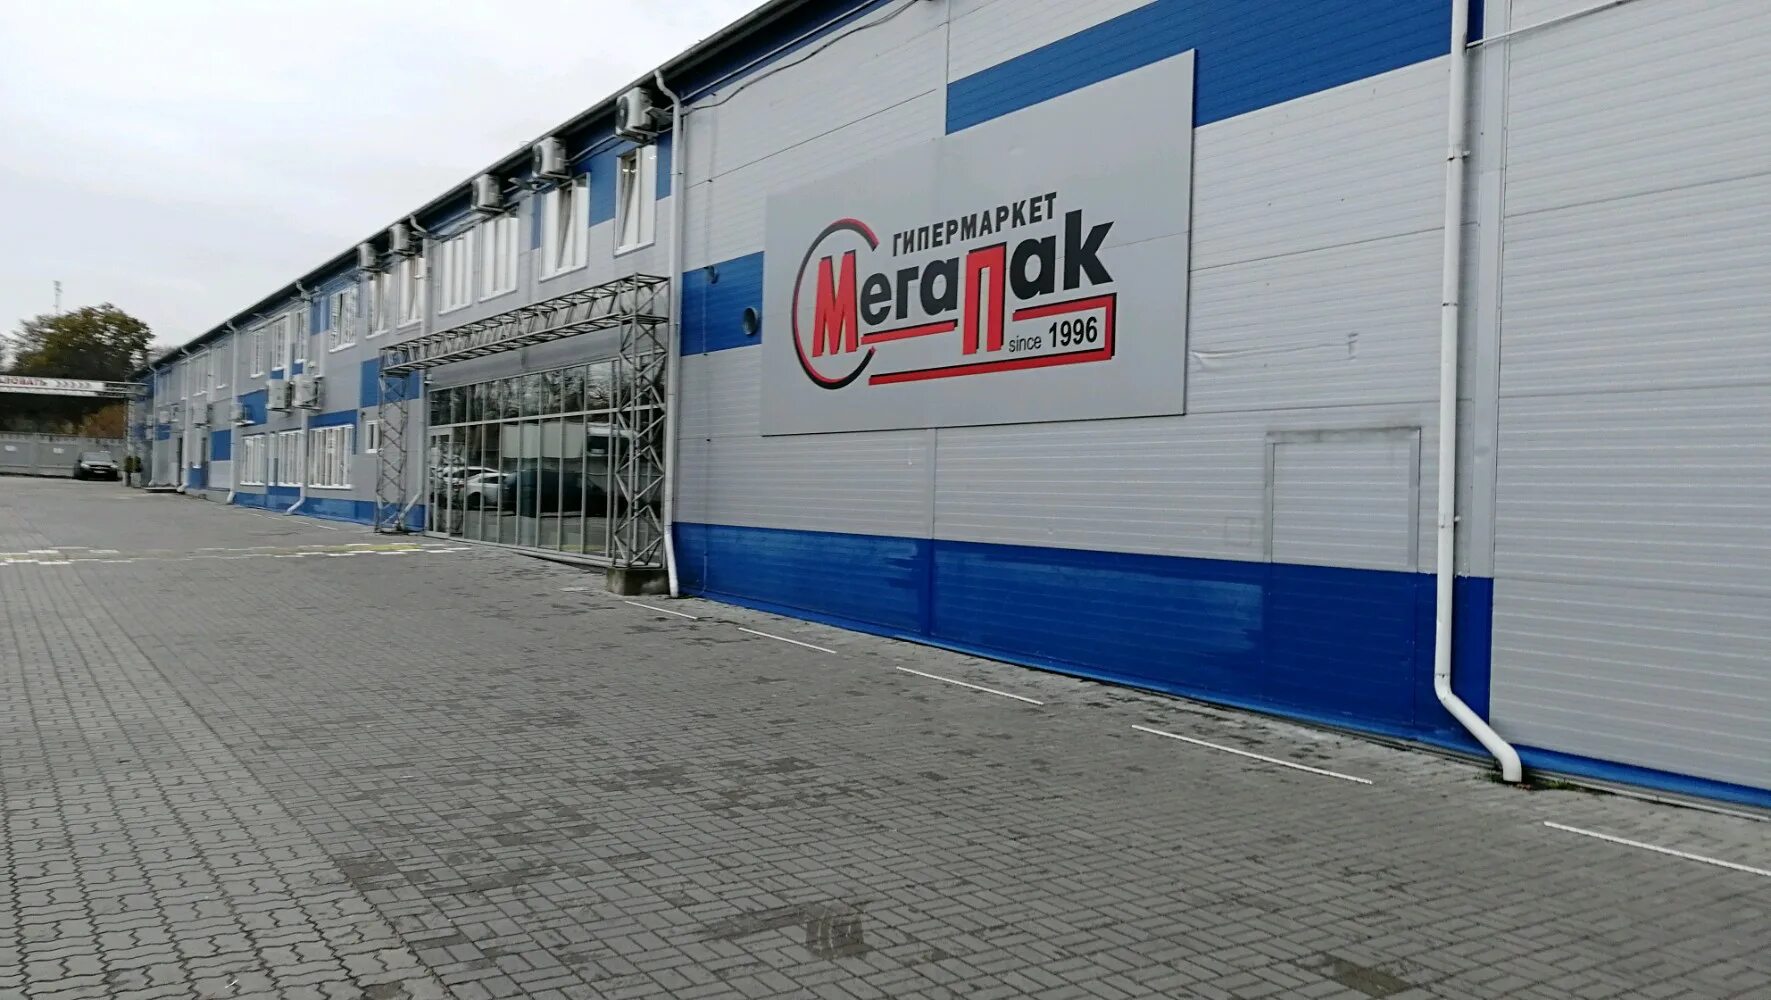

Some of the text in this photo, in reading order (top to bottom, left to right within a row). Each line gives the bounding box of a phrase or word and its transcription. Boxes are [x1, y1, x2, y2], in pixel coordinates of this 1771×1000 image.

[892, 192, 1057, 257] ГИПЕРМАРКЕТ
[812, 208, 1115, 357] МегаПак
[1008, 316, 1099, 354] since 1996
